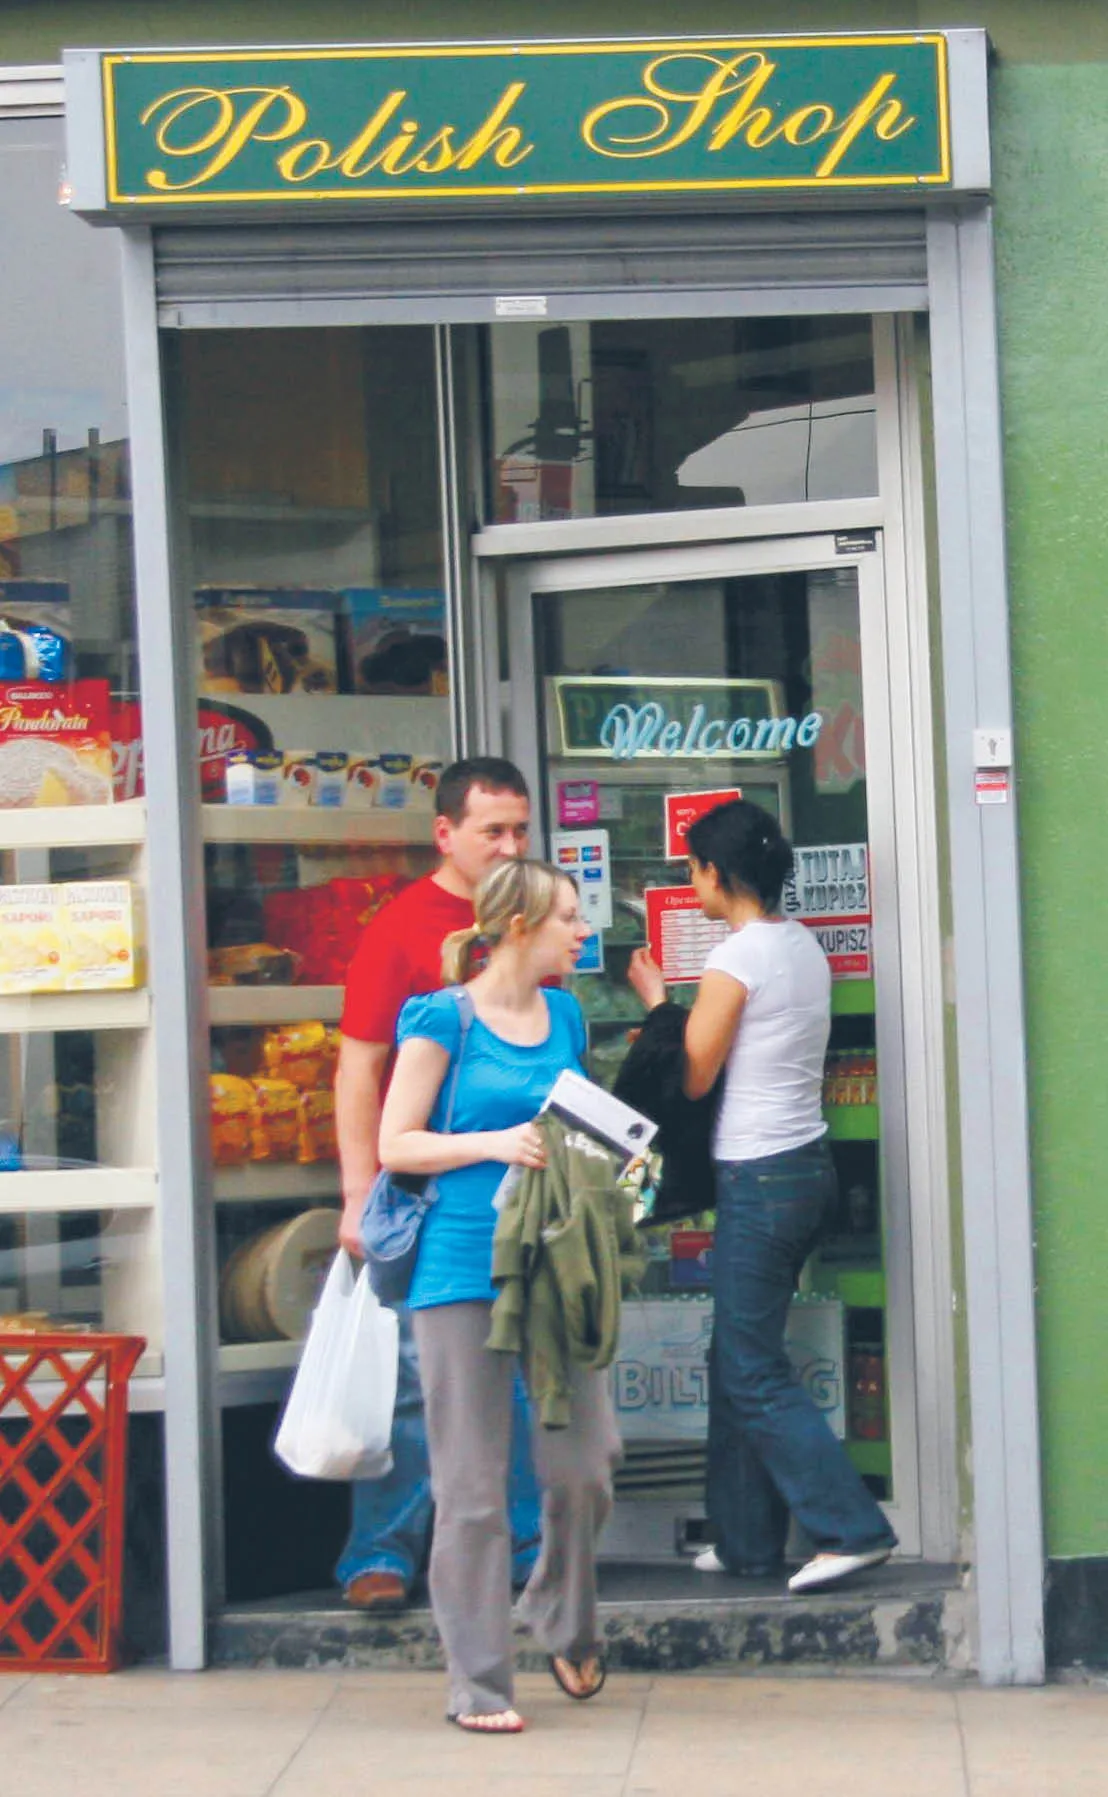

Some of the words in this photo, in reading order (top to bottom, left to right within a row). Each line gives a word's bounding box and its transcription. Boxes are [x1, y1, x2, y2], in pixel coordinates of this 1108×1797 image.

[139, 82, 534, 191] Polish
[582, 52, 916, 177] Shop
[600, 702, 823, 759] Welcome
[815, 928, 867, 953] KUPISZ
[615, 1357, 839, 1412] BILTG
